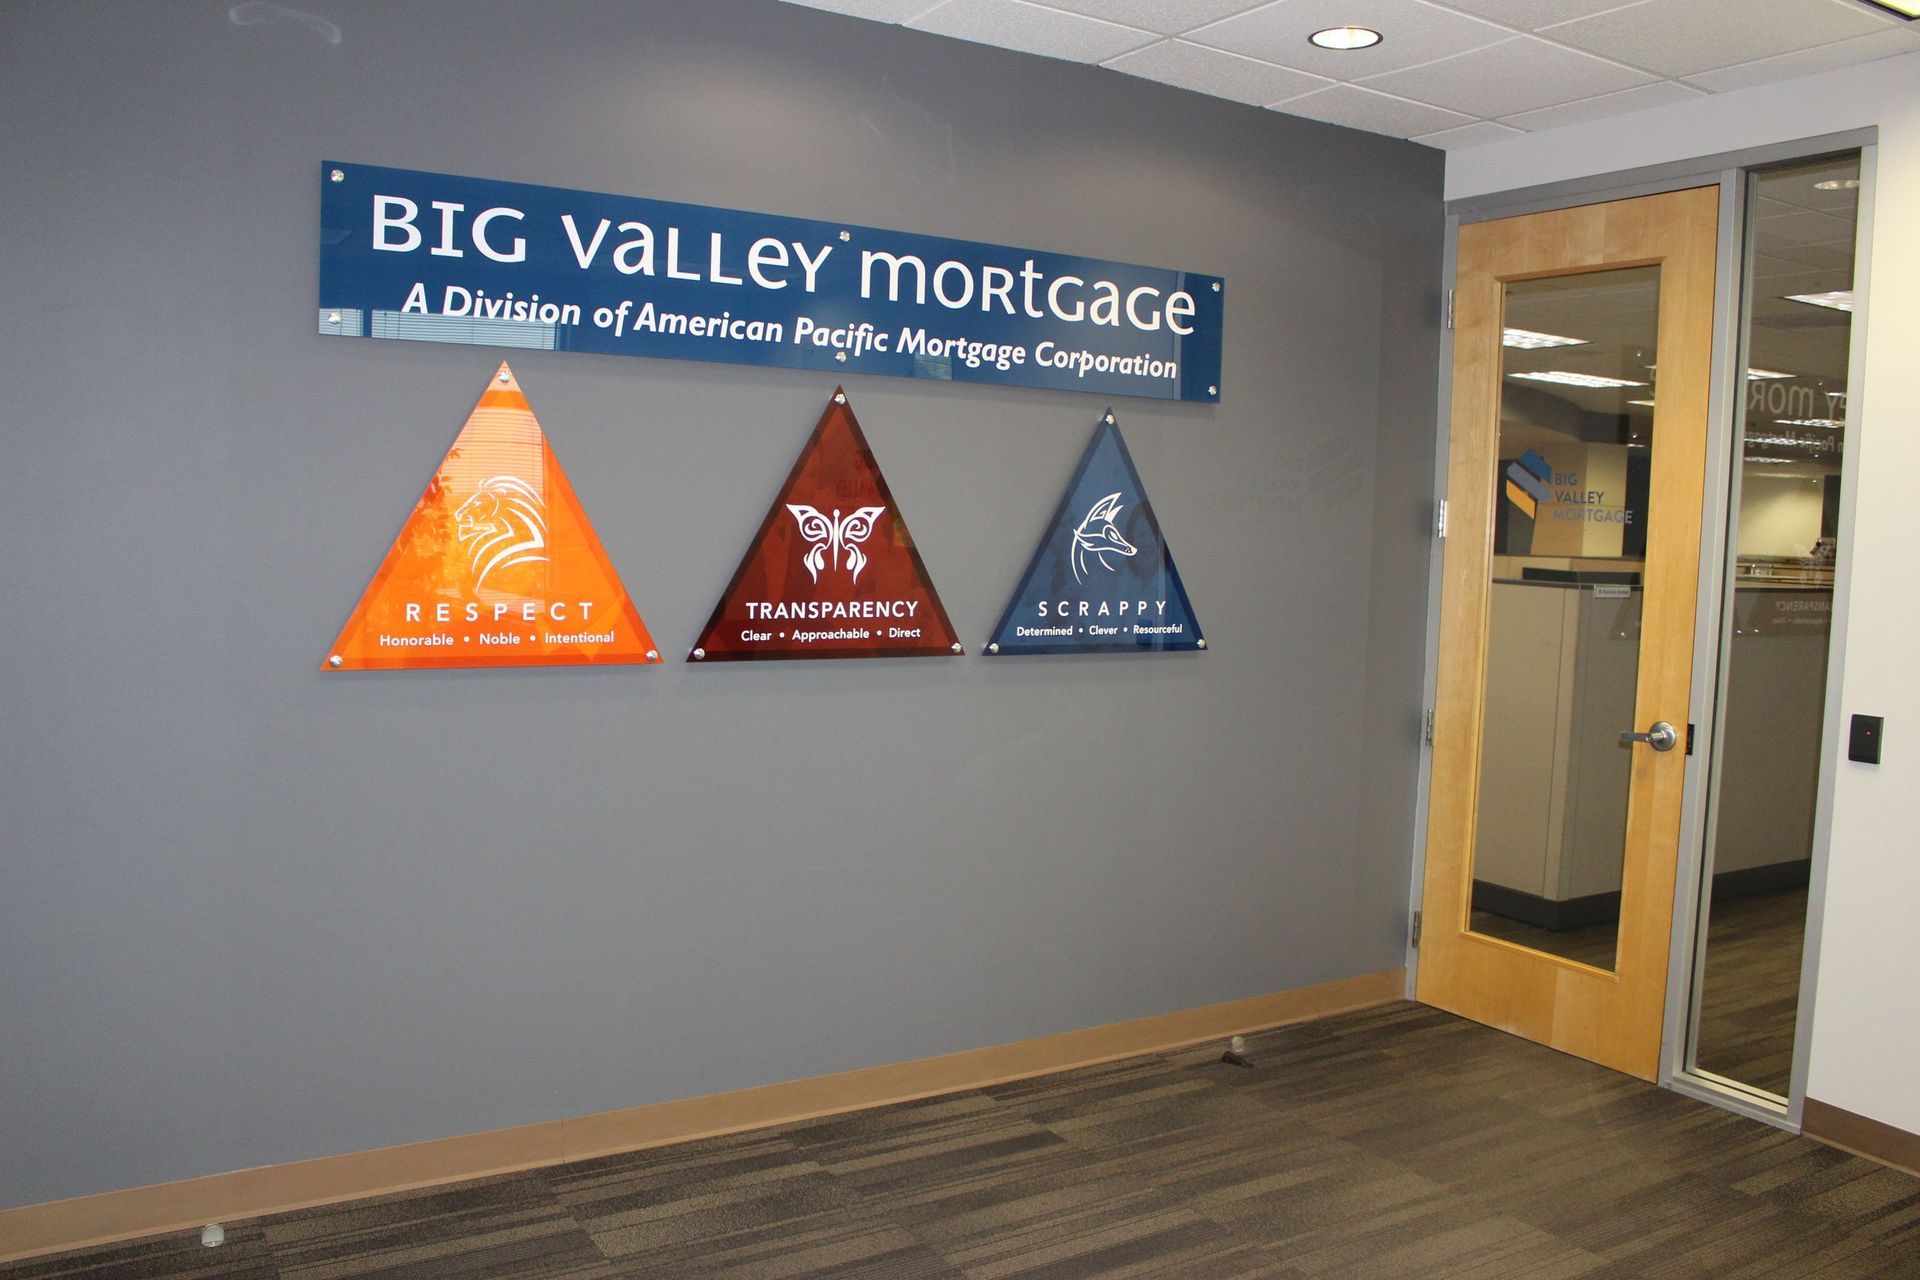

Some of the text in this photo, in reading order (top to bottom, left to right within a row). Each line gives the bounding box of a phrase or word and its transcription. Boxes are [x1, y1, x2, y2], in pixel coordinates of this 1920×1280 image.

[372, 194, 527, 264] BIG
[400, 282, 1178, 379] A Division of American Pacific Mortgage Corporation
[1555, 472, 1578, 486] BIG
[1555, 490, 1605, 505] VALLEY
[1552, 508, 1634, 525] MORTGAGE
[405, 601, 594, 622] RESPECT
[745, 600, 919, 620] TRANSPARENCY
[1038, 600, 1167, 617] SCRAPPY
[740, 627, 921, 643] Clear Approachable Direct
[1016, 623, 1183, 637] Determined Clever Resourceful
[380, 631, 615, 647] Honorable Noble Intentional
